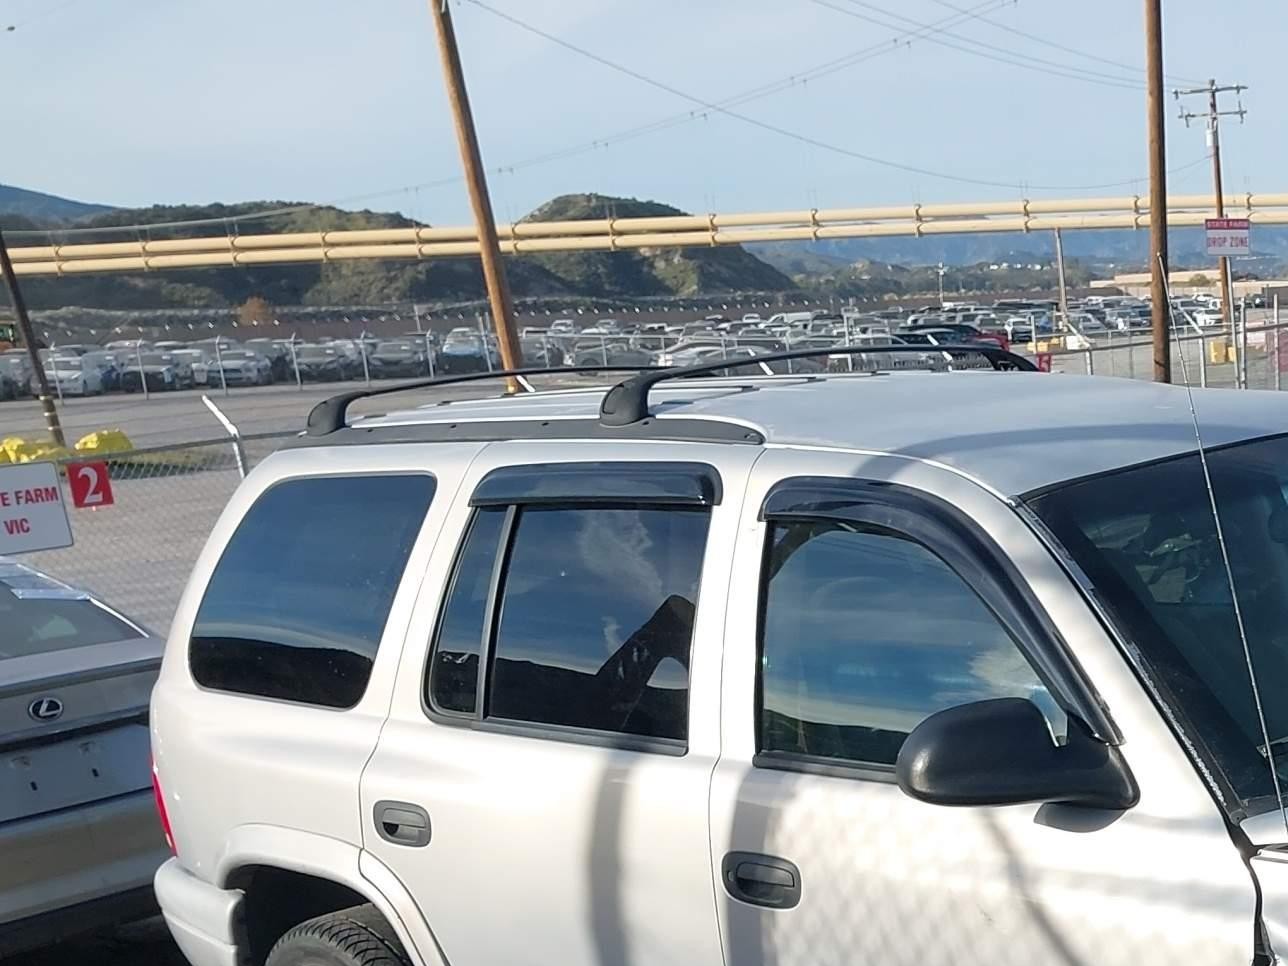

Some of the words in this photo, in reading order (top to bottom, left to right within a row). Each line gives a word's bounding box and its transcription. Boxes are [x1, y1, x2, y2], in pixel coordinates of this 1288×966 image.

[1207, 236, 1227, 248] DROP
[1230, 236, 1248, 248] ZONE
[78, 466, 103, 504] 2
[14, 486, 59, 505] FARM
[3, 518, 31, 535] VIC
